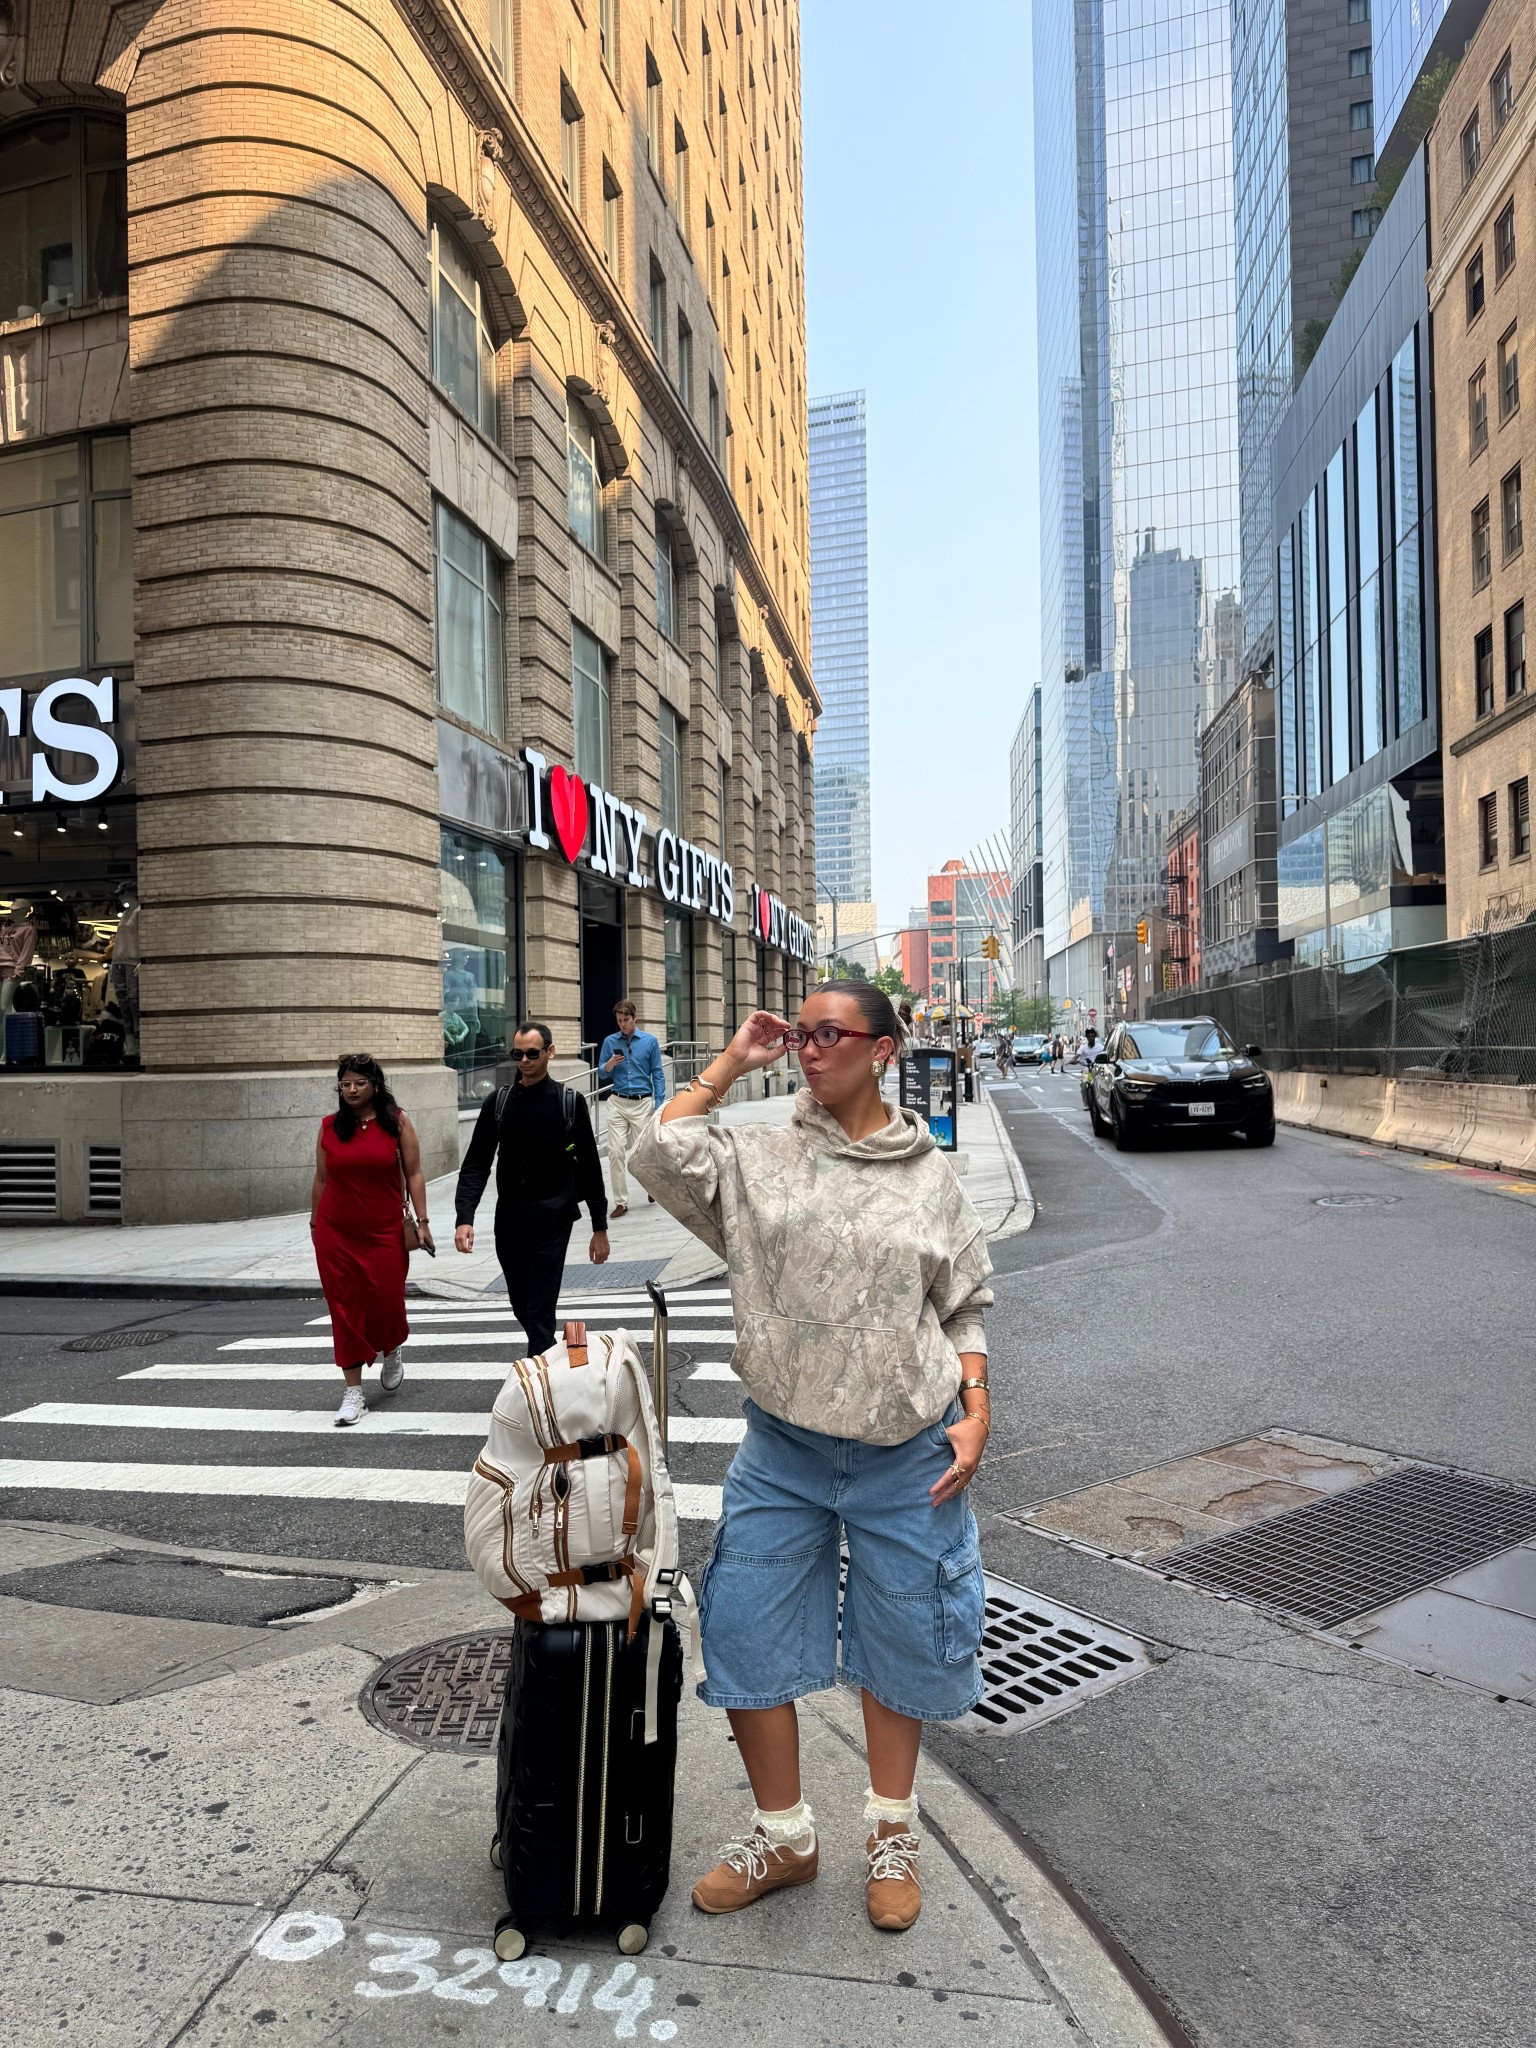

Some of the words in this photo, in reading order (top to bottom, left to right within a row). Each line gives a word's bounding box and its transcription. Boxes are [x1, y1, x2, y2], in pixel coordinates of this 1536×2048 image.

[525, 746, 550, 850] I
[657, 827, 734, 923] GIFTS
[788, 910, 814, 965] GIFTS
